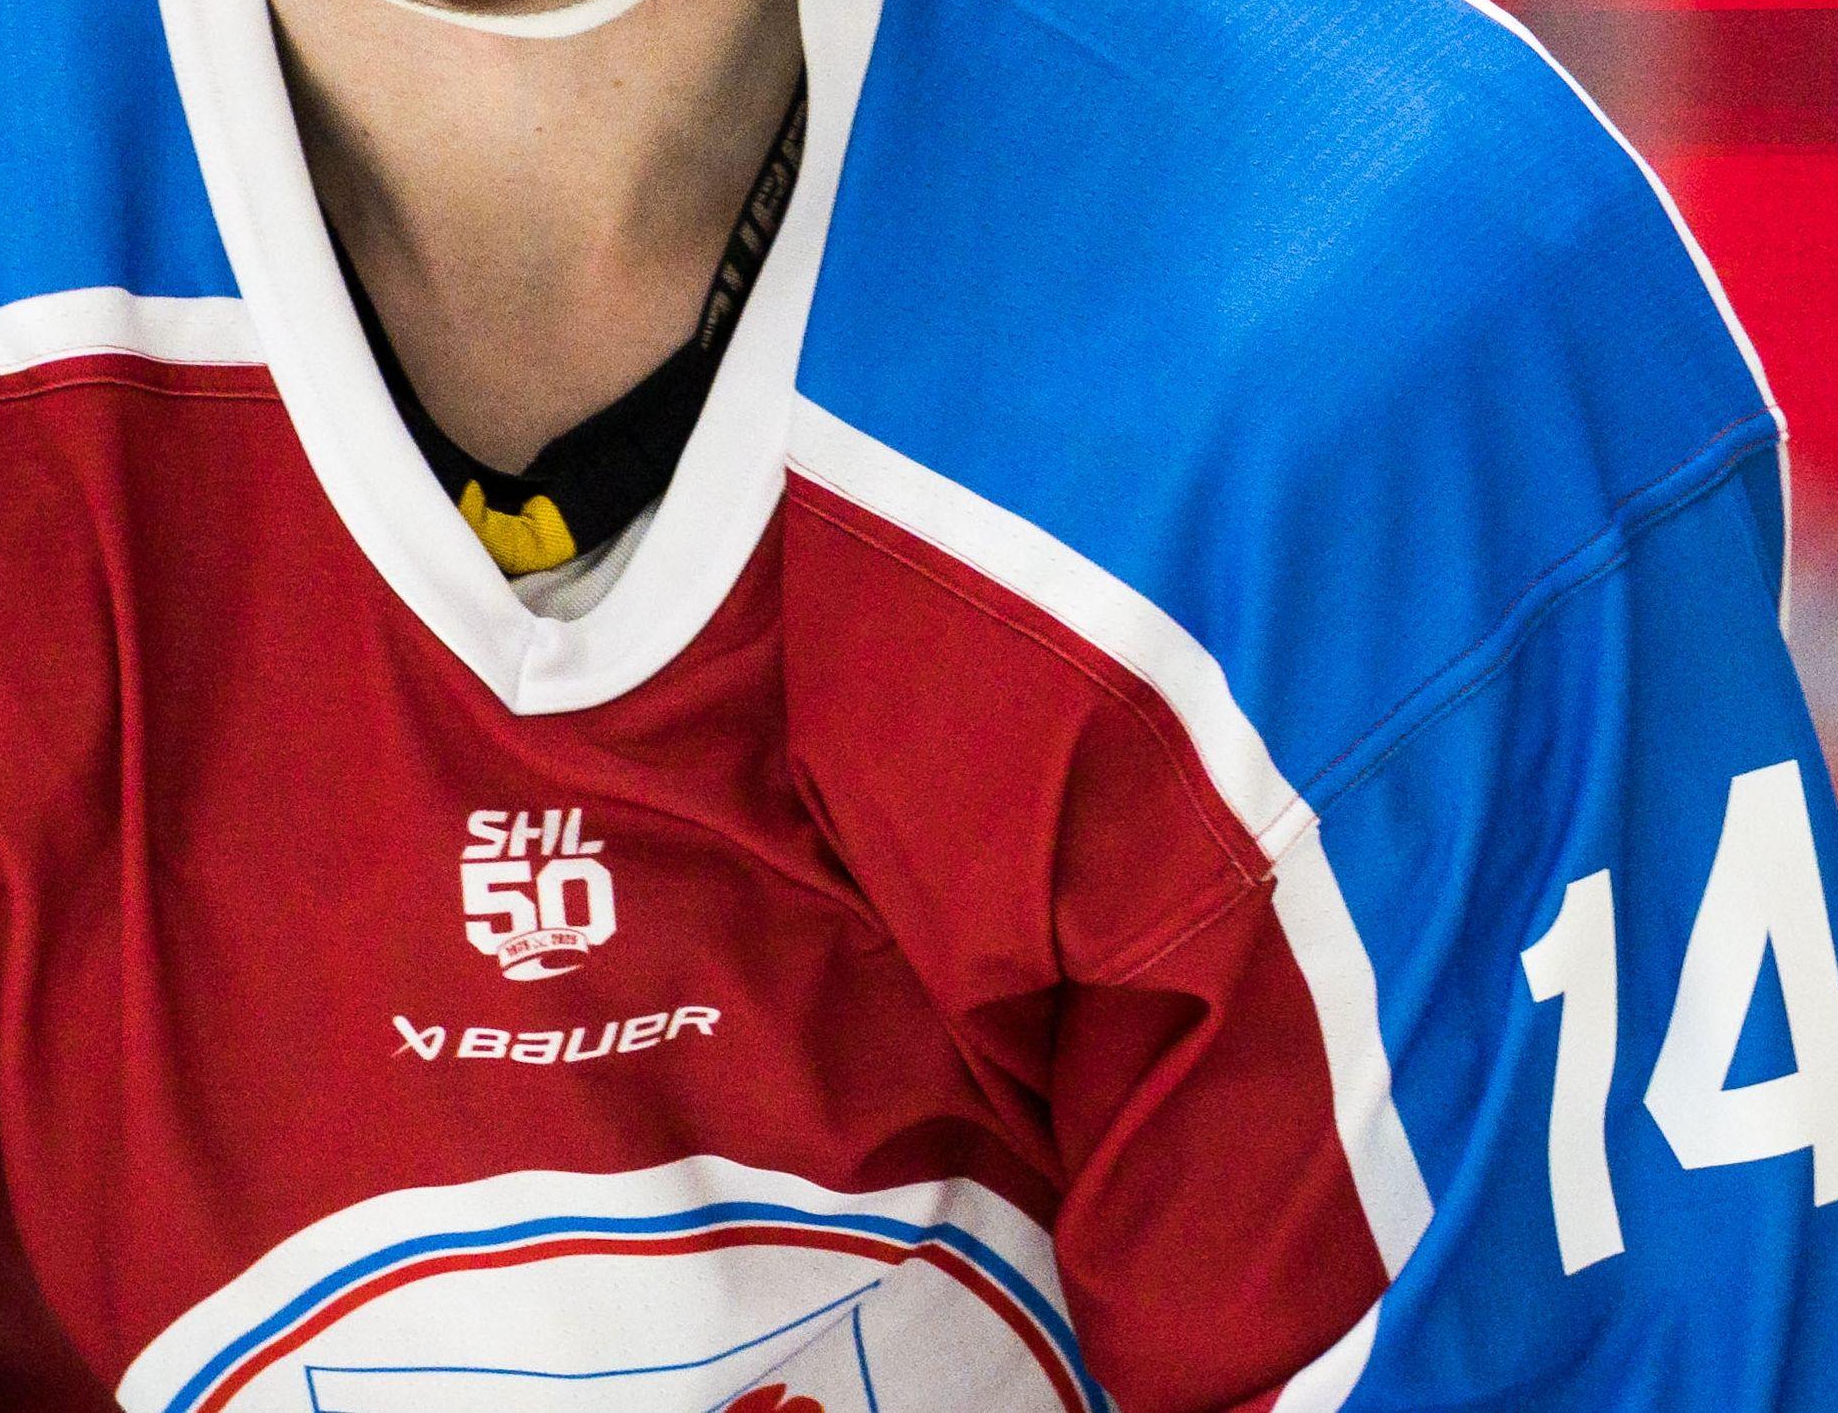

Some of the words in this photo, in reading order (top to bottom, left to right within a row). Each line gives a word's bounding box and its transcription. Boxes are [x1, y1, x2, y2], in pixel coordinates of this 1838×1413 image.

[462, 807, 606, 859] SHL
[461, 857, 617, 956] 50
[457, 1005, 721, 1065] BAUER
